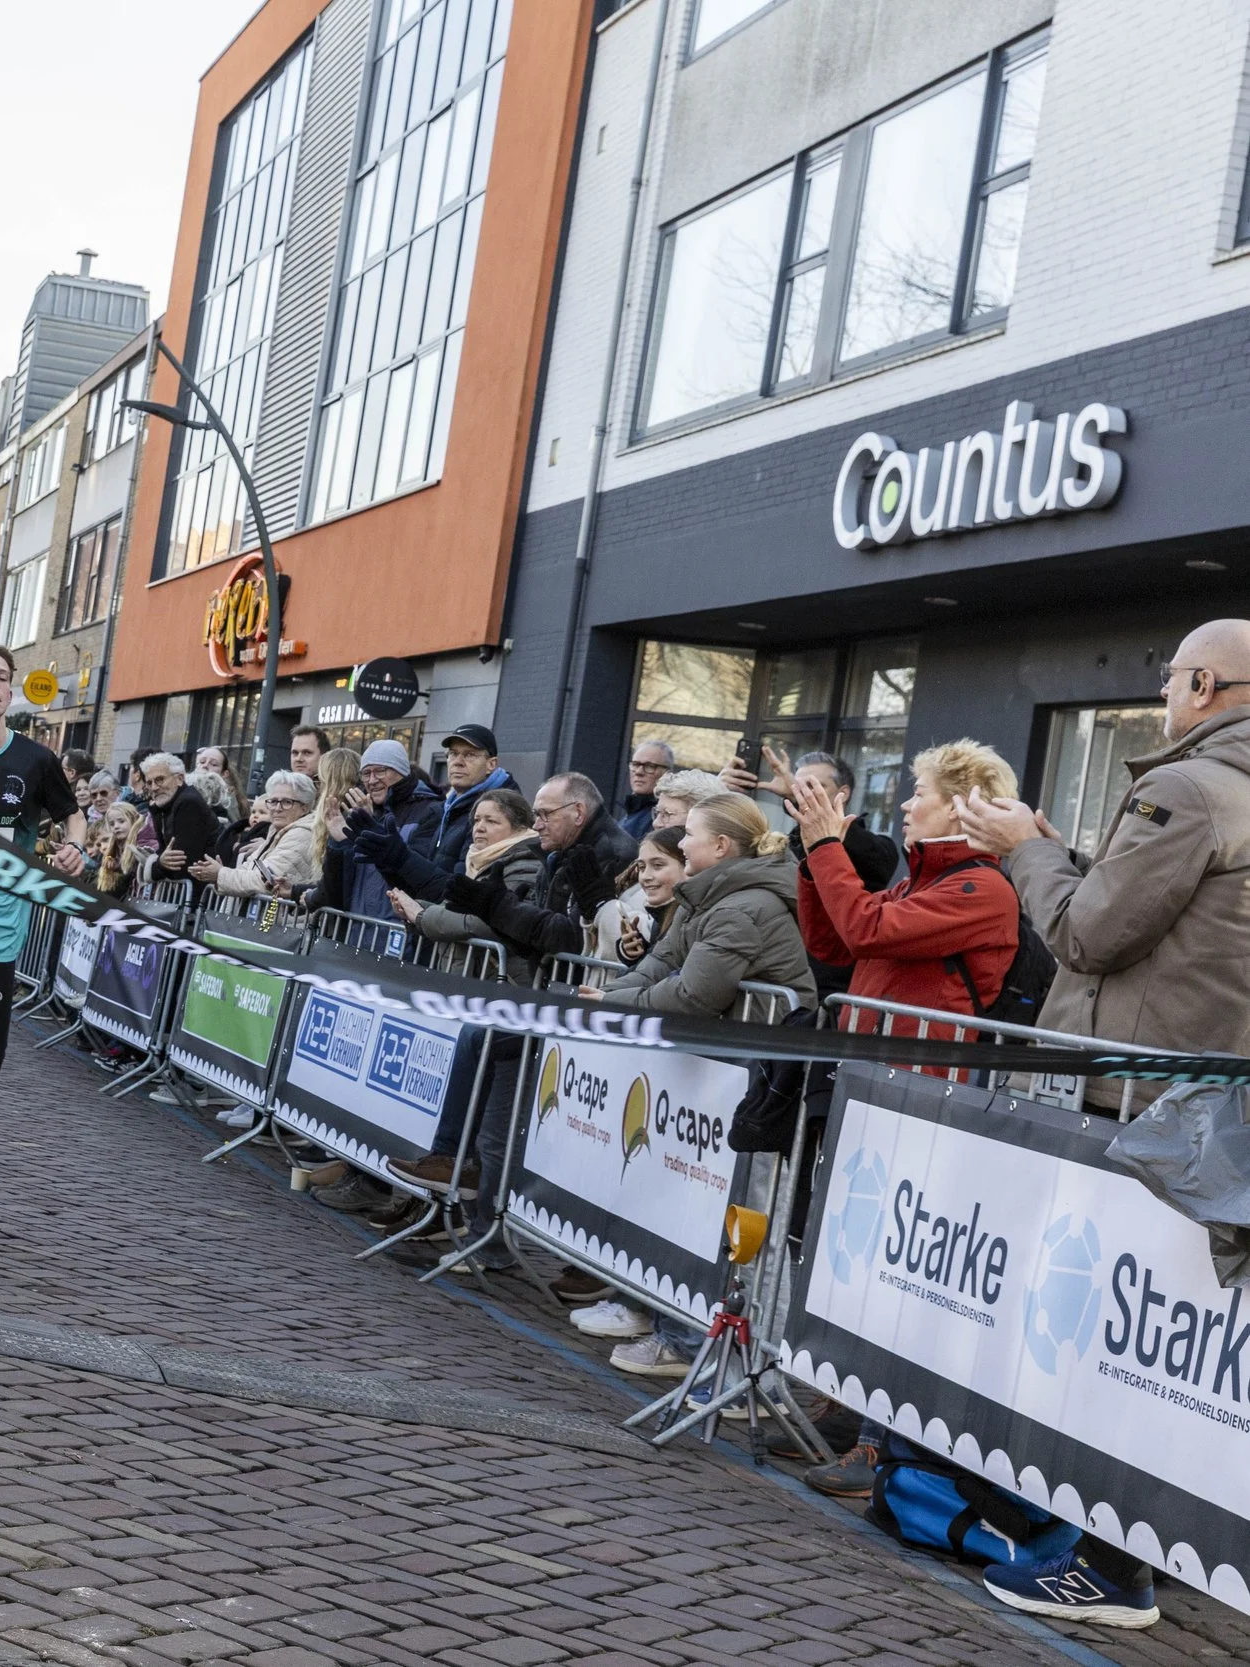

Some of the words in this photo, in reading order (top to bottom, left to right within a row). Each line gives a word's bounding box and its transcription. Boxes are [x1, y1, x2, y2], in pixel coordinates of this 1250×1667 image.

[832, 400, 1127, 550] Countus
[359, 681, 380, 691] CASA
[393, 687, 417, 696] PASTA
[318, 705, 342, 724] CASA
[343, 704, 356, 721] DI
[198, 973, 224, 1000] SAFEBOX
[237, 987, 272, 1017] SAFEBOX
[334, 1008, 371, 1044] MACHINE
[329, 1036, 363, 1072] VERHUUR
[410, 1035, 452, 1076] MACHINE
[403, 1066, 443, 1106] VERHUUR
[563, 1057, 608, 1119] Q-cape
[655, 1089, 723, 1162] Q-cape
[664, 1151, 689, 1181] trading
[689, 1165, 711, 1190] quality
[710, 1173, 728, 1195] crops
[885, 1178, 1008, 1305] Starke
[879, 1270, 921, 1297] RE-INTEGRATIE
[920, 1287, 926, 1299] &
[925, 1289, 996, 1329] PERSONEELSDIENSTEN
[1104, 1252, 1250, 1404] Stark
[1098, 1360, 1160, 1397] RE-INTEGRATIE
[1160, 1385, 1167, 1399] &
